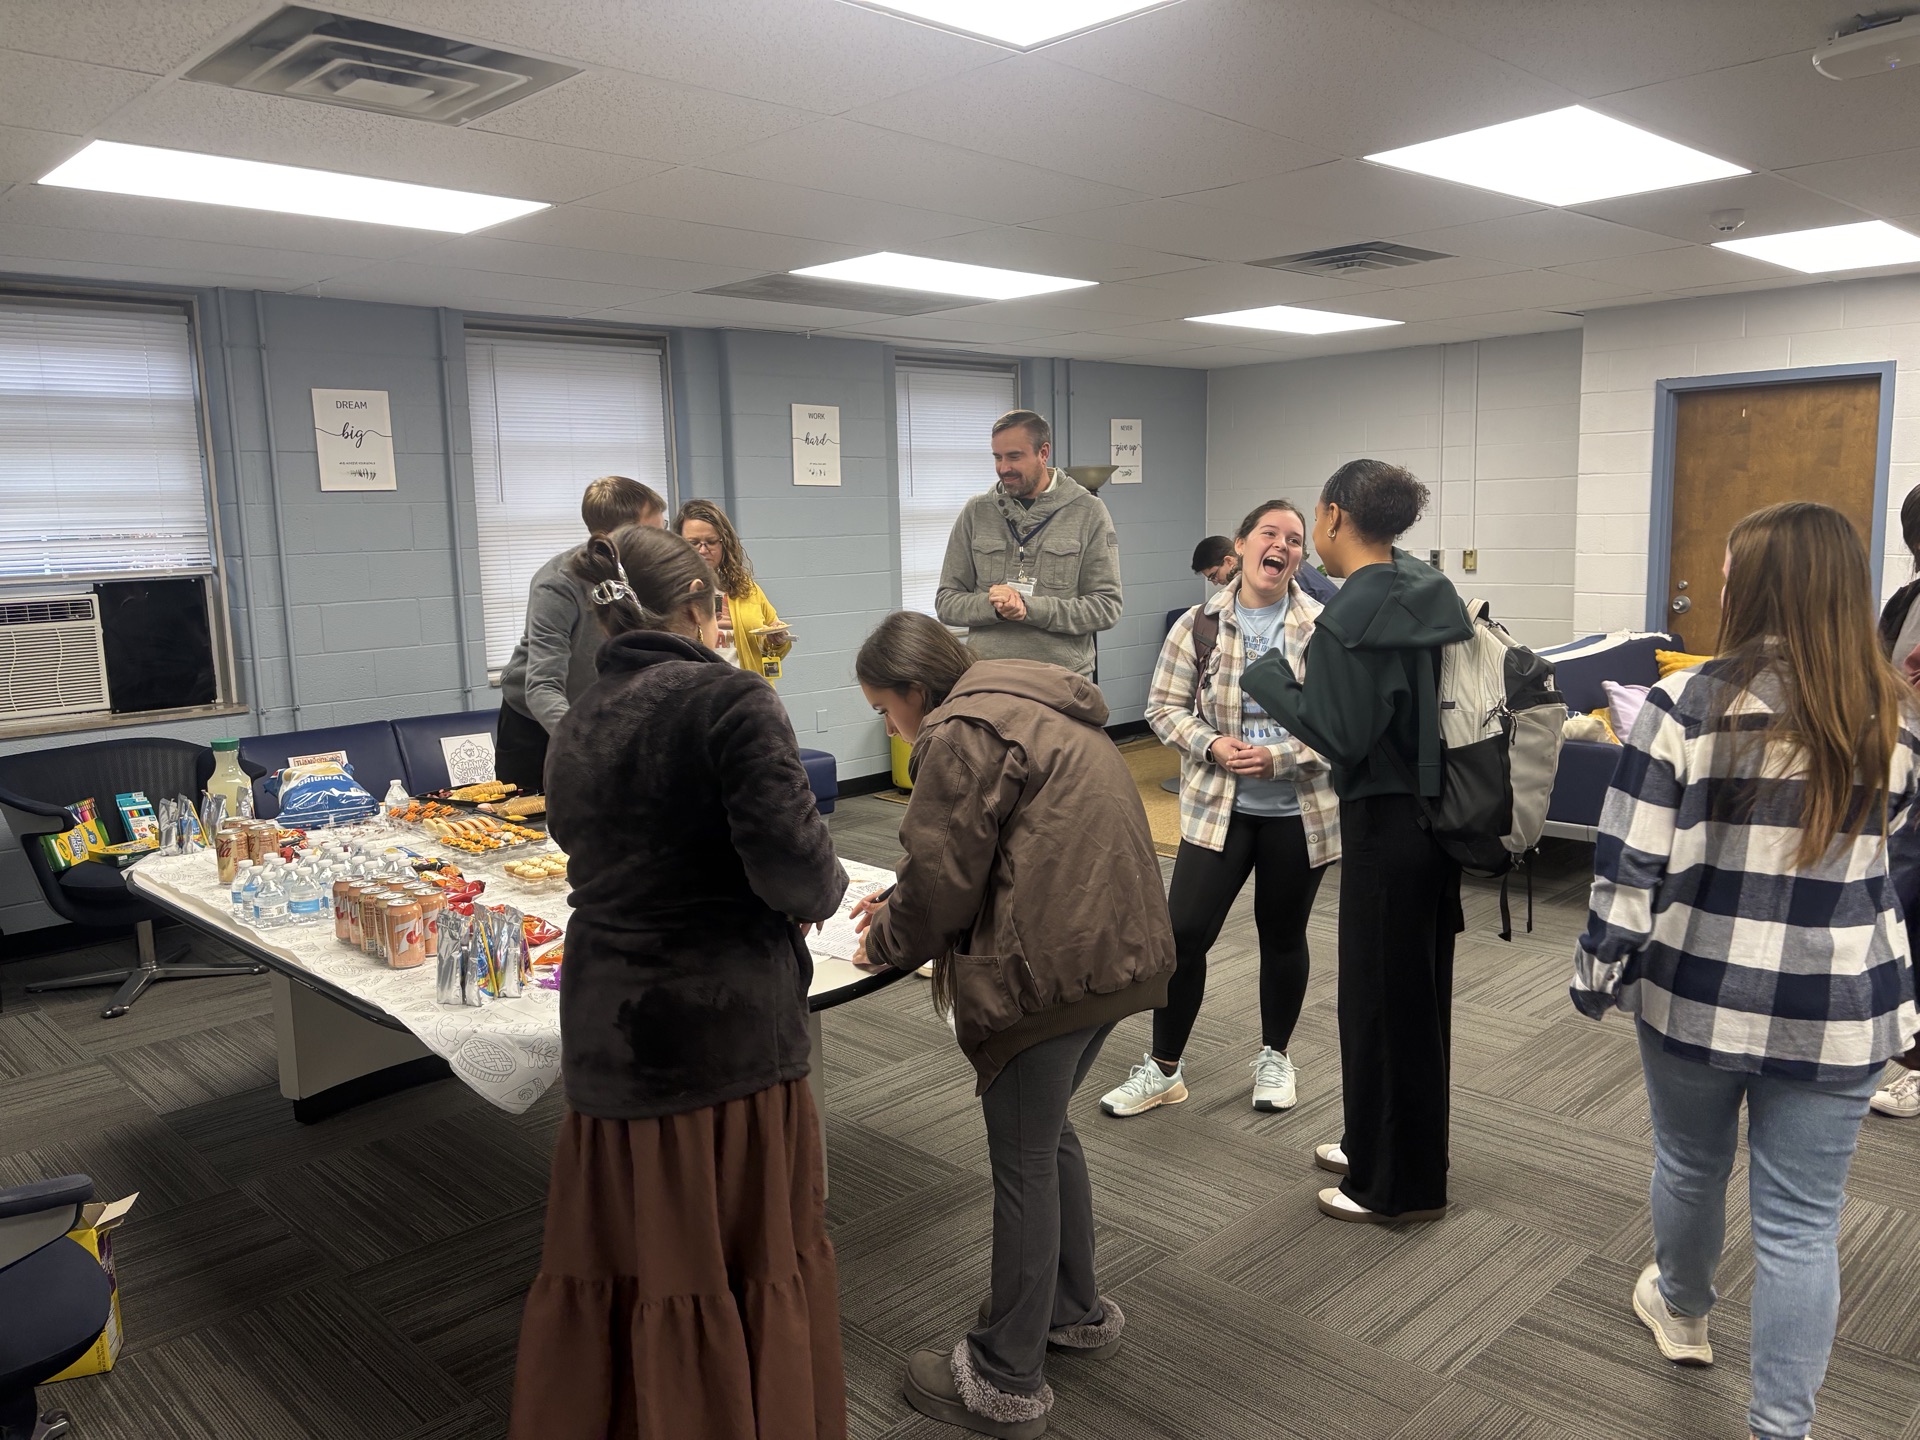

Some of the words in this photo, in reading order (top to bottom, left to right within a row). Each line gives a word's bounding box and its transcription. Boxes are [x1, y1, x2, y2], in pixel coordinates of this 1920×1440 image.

[335, 400, 368, 409] DREAM
[808, 412, 826, 420] WORK
[342, 422, 363, 448] big
[805, 431, 827, 446] hard
[1115, 442, 1128, 457] give
[1129, 444, 1137, 457] up
[460, 759, 489, 769] THANKS
